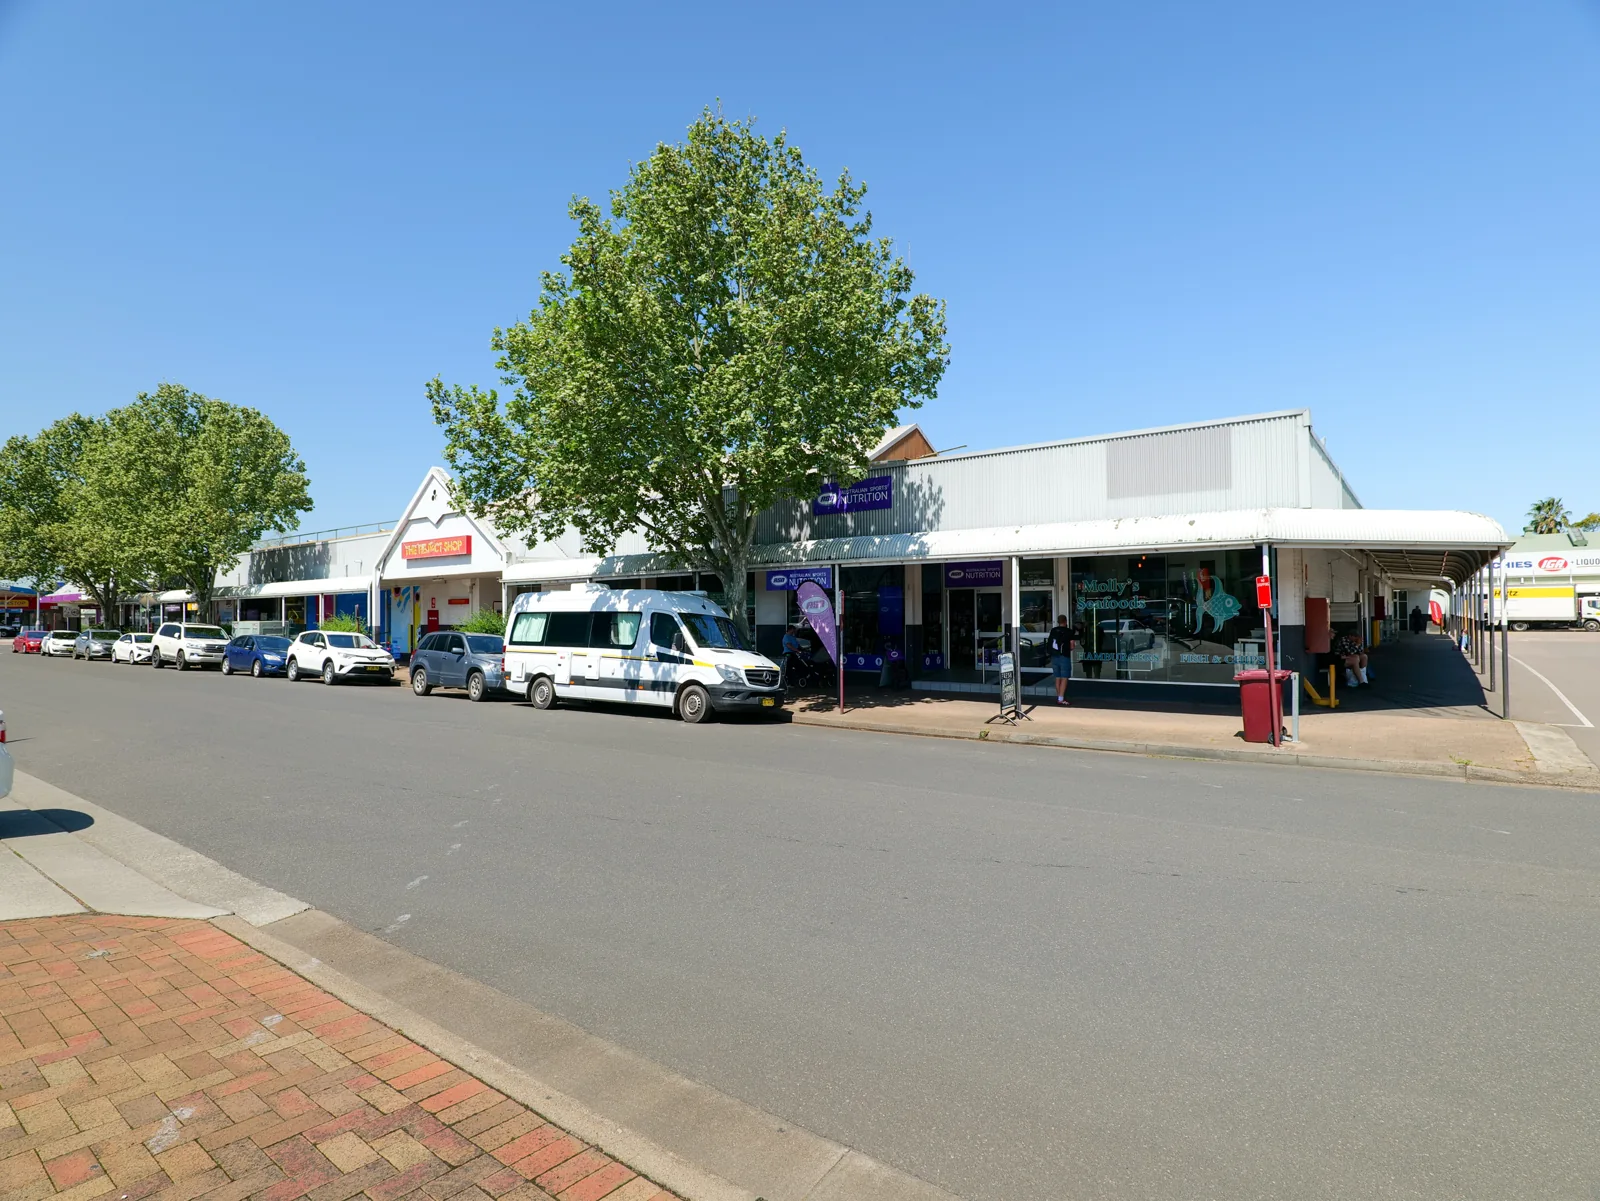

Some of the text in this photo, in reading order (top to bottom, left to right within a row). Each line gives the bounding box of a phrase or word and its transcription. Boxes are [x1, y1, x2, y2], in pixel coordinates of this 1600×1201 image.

[841, 491, 888, 505] NUTRITION
[404, 544, 417, 556] THE
[443, 540, 462, 552] SHOP
[1541, 560, 1566, 569] IGA
[1082, 578, 1140, 596] Molly's
[1077, 595, 1146, 610] Seafoods
[1076, 652, 1160, 662] HAMBURGERS
[1180, 654, 1265, 665] FISH & CHIPS
